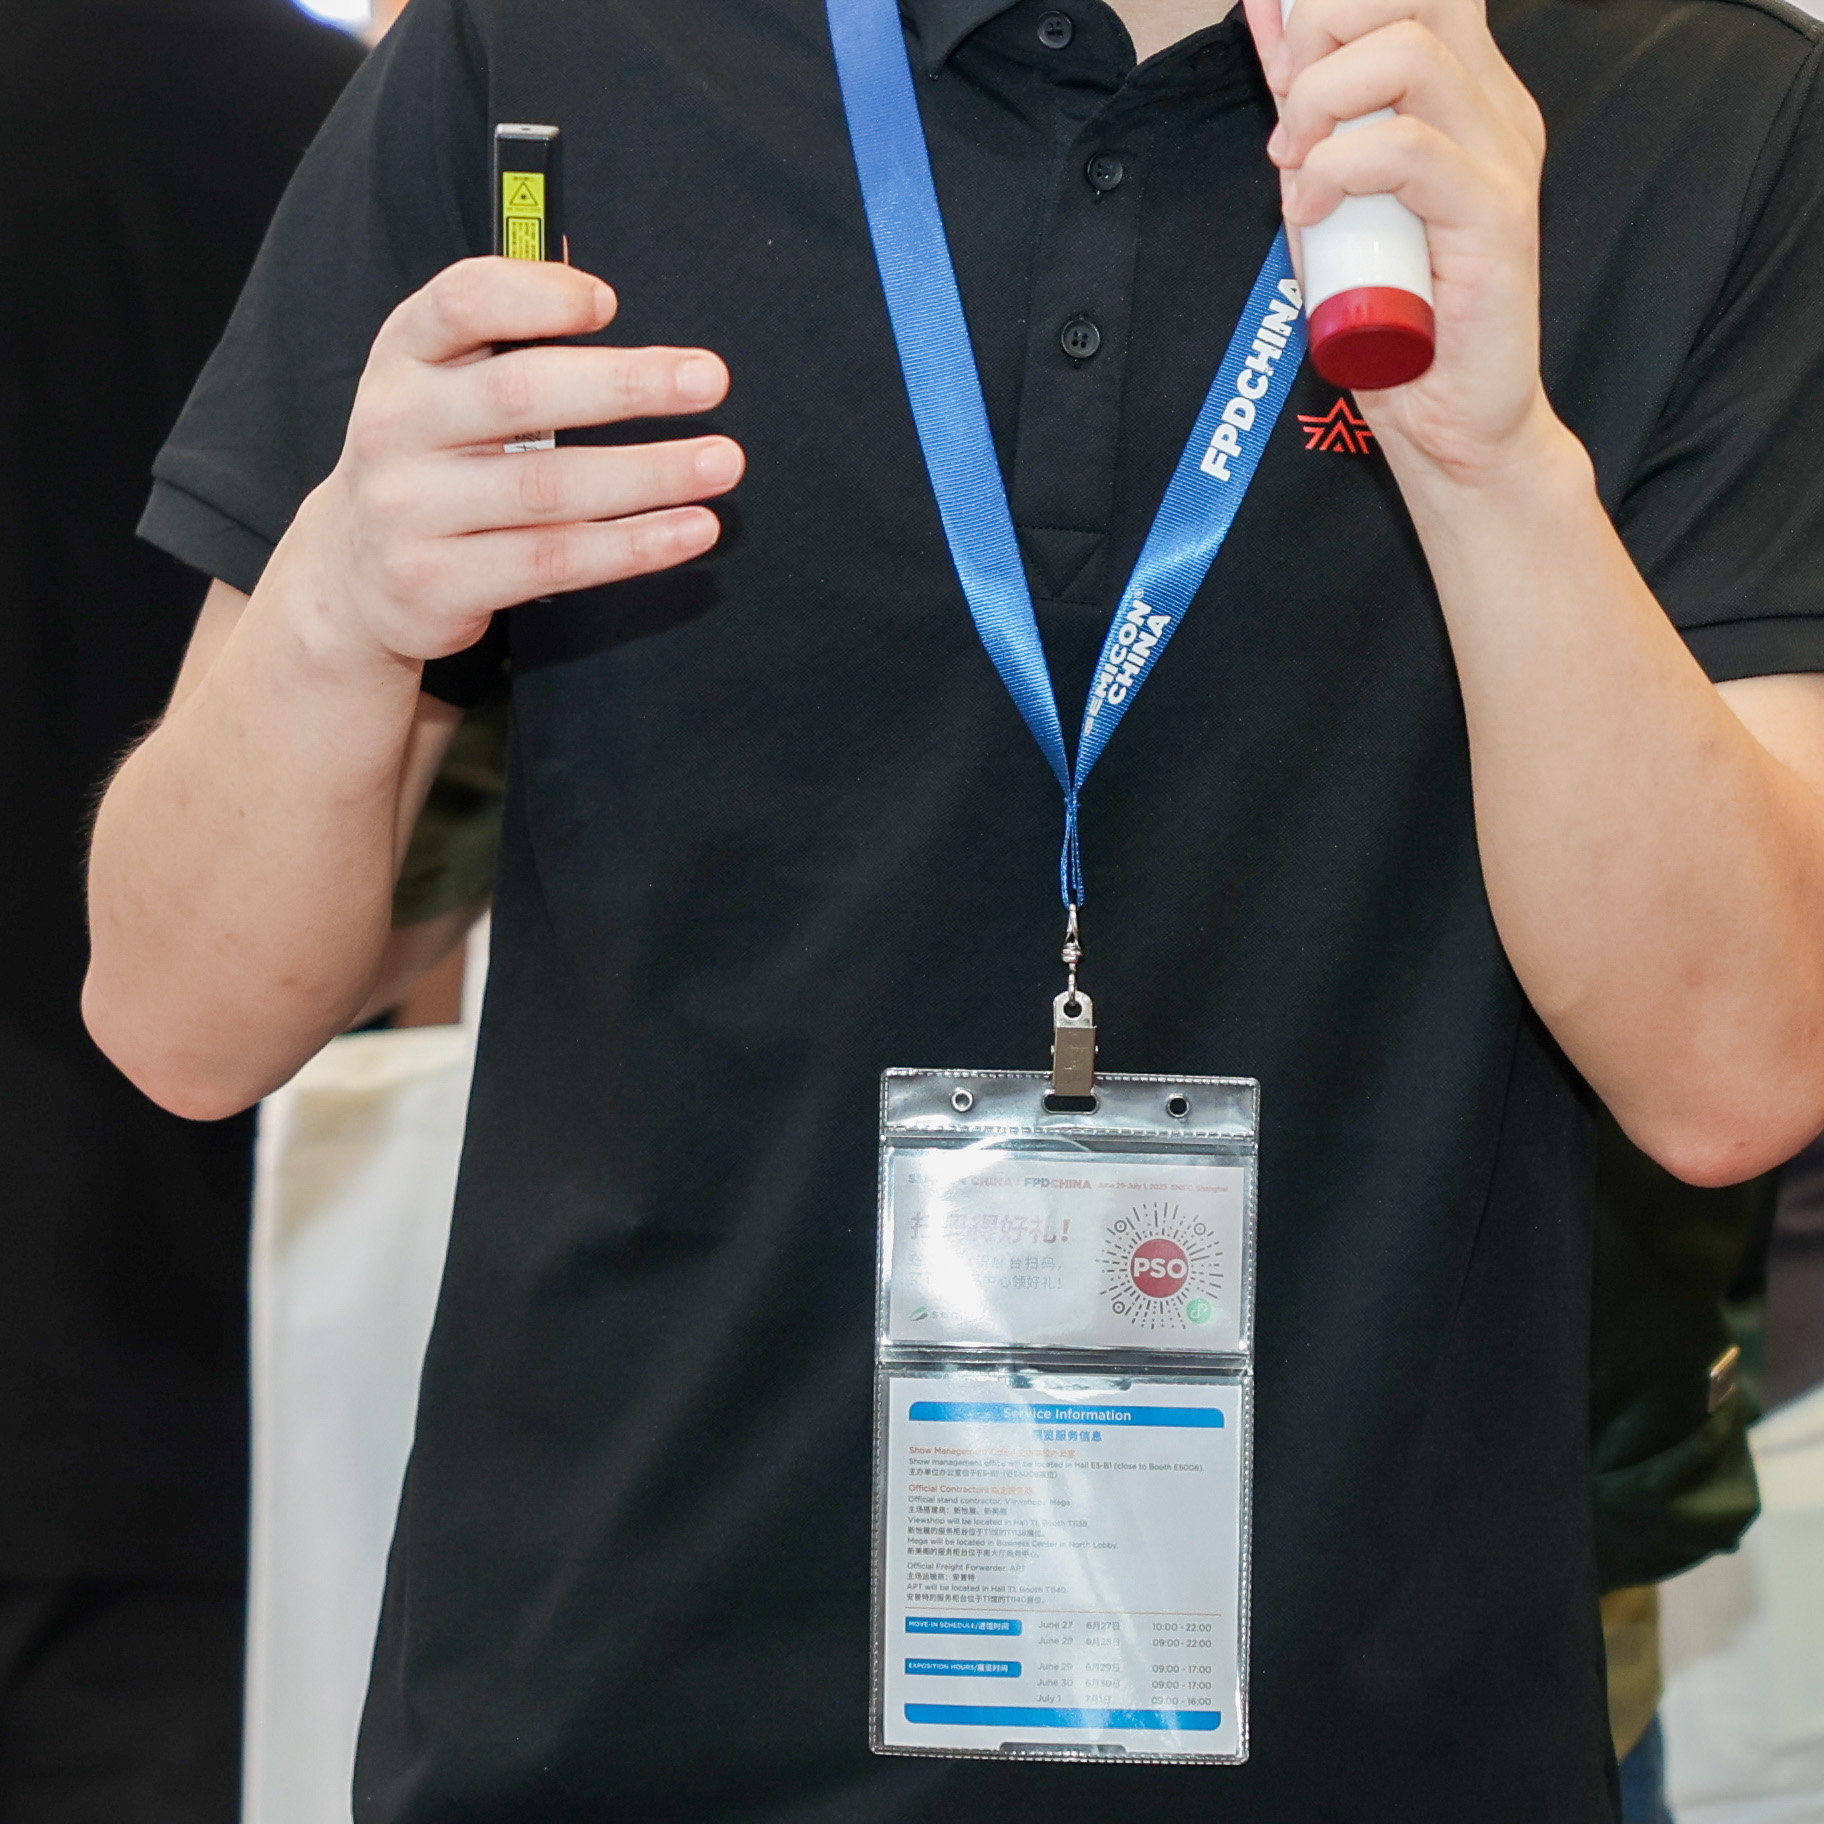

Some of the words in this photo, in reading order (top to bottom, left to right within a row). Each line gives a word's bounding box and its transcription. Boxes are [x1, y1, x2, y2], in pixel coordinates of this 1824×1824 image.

[1200, 278, 1306, 482] FPDCHINA
[1108, 614, 1172, 705] CHINA
[1132, 1256, 1188, 1278] PSO
[1003, 1407, 1052, 1420] Service
[1055, 1408, 1132, 1422] Information
[1152, 1622, 1178, 1632] 10:00
[1185, 1623, 1212, 1633] 22:00
[1186, 1640, 1212, 1648] 22:00
[1188, 1665, 1212, 1674] 17:00
[1188, 1681, 1212, 1690] 17:00
[1187, 1697, 1212, 1706] 16:00
